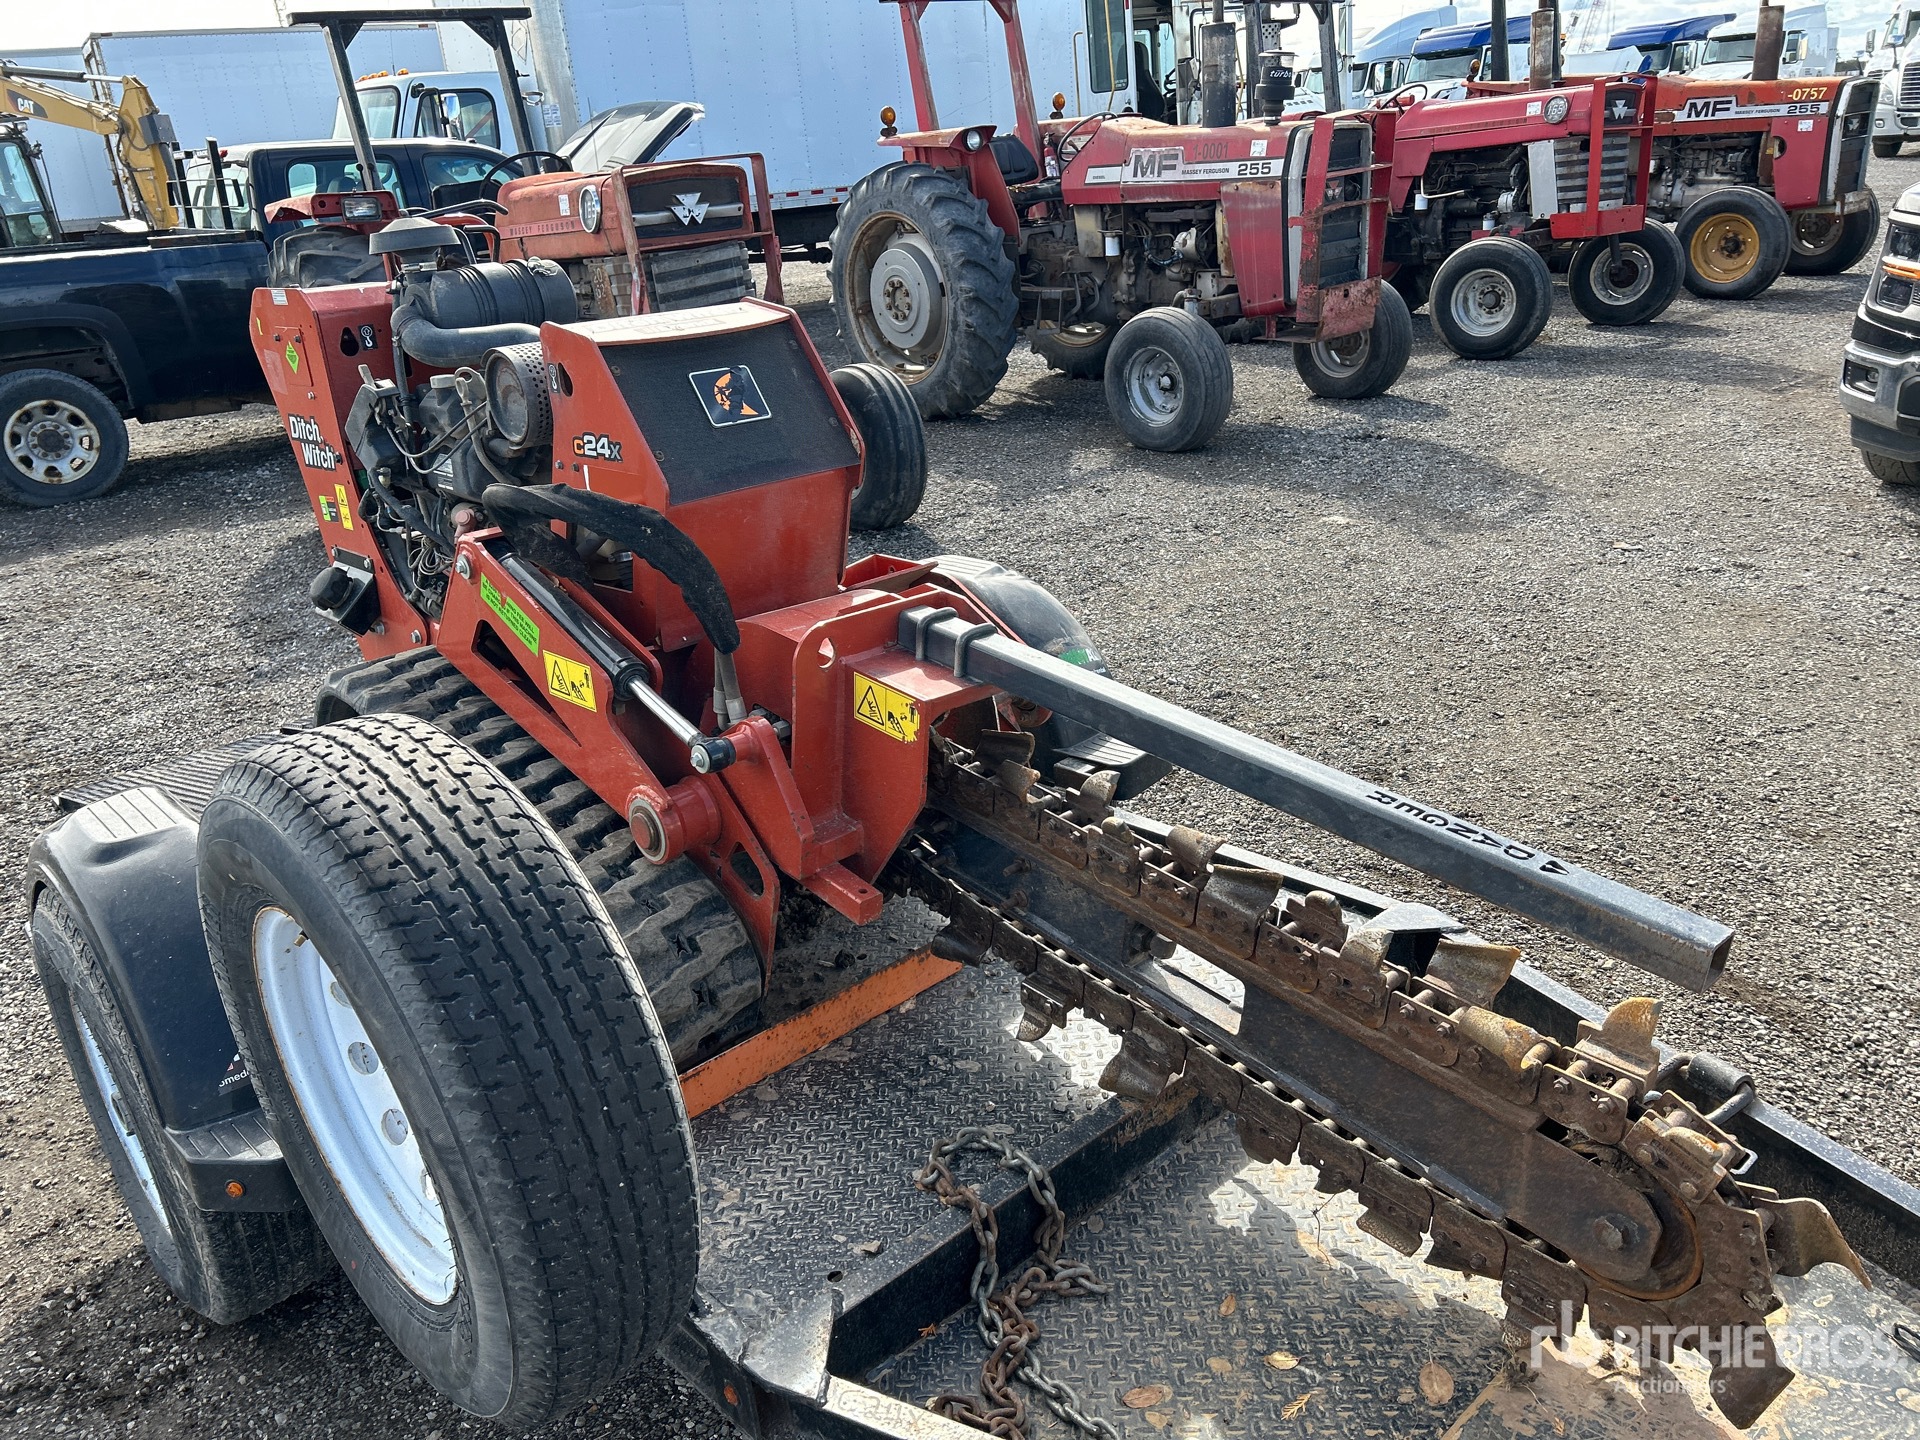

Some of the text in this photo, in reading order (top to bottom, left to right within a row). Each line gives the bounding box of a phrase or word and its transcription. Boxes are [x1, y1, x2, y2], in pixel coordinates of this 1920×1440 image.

[1787, 87, 1827, 101] -0757
[17, 97, 34, 114] CAT
[1547, 104, 1564, 116] 165
[1687, 100, 1733, 119] MF
[1786, 103, 1821, 115] 255
[1132, 153, 1180, 178] MF
[1202, 167, 1230, 175] FERGUSON
[1237, 162, 1272, 176] 255
[537, 220, 577, 234] FERGUSON
[301, 442, 337, 470] Witch
[1365, 790, 1536, 861] DANGER
